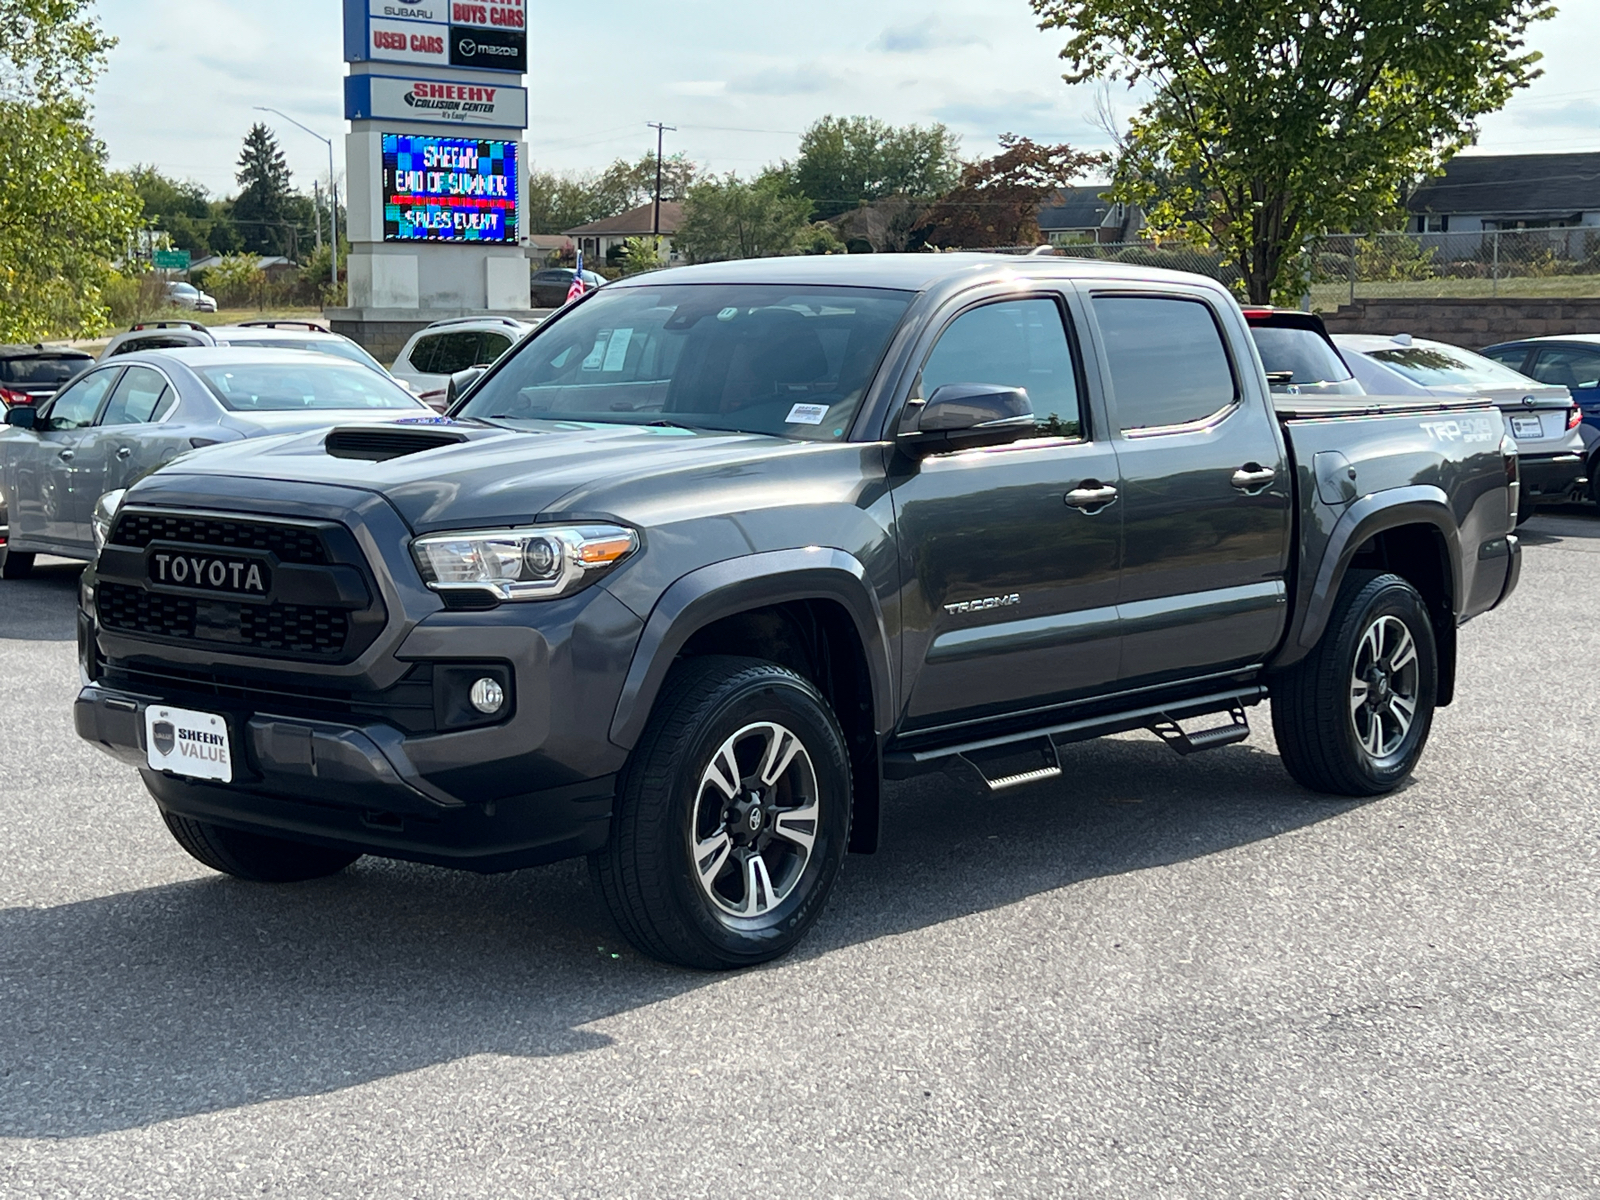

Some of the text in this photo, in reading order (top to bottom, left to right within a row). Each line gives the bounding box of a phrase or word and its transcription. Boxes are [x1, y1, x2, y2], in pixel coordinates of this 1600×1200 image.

[384, 6, 433, 19] SUBARU
[453, 3, 524, 27] BUYS CARS
[373, 30, 444, 54] USED CARS
[477, 44, 518, 56] mazda
[413, 83, 497, 102] SHEEHY
[414, 98, 495, 113] COLLISION CENTER
[441, 110, 451, 119] It's
[395, 170, 424, 192] END
[427, 172, 446, 193] OF
[405, 210, 499, 230] SALES EVENT
[1419, 420, 1462, 442] TRD
[1463, 432, 1493, 443] SPORT
[156, 554, 263, 590] TOYOTA
[943, 593, 1021, 615] TACOMA
[178, 728, 224, 746] SHEEHY
[179, 741, 227, 764] VALUE
